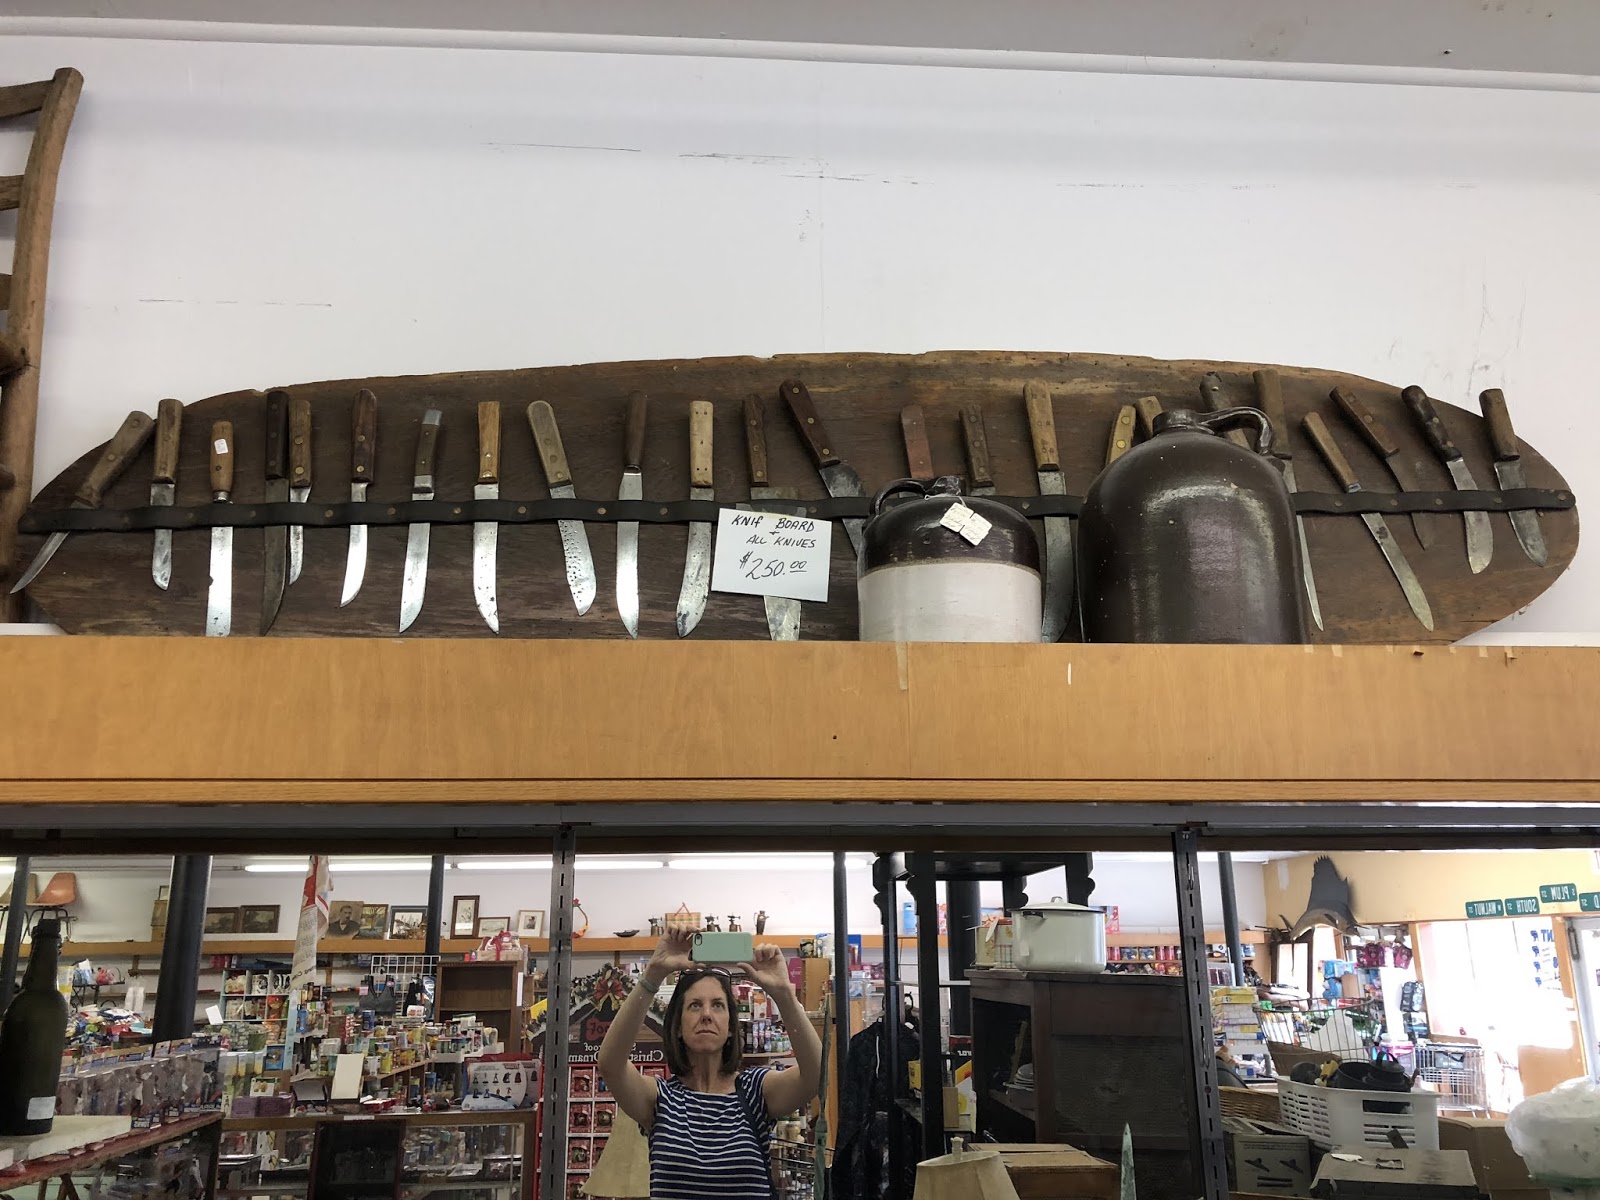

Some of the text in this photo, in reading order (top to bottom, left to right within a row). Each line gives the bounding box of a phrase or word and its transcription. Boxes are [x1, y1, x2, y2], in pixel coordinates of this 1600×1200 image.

[774, 517, 815, 532] BOARD
[746, 534, 817, 549] ALL KNIVES
